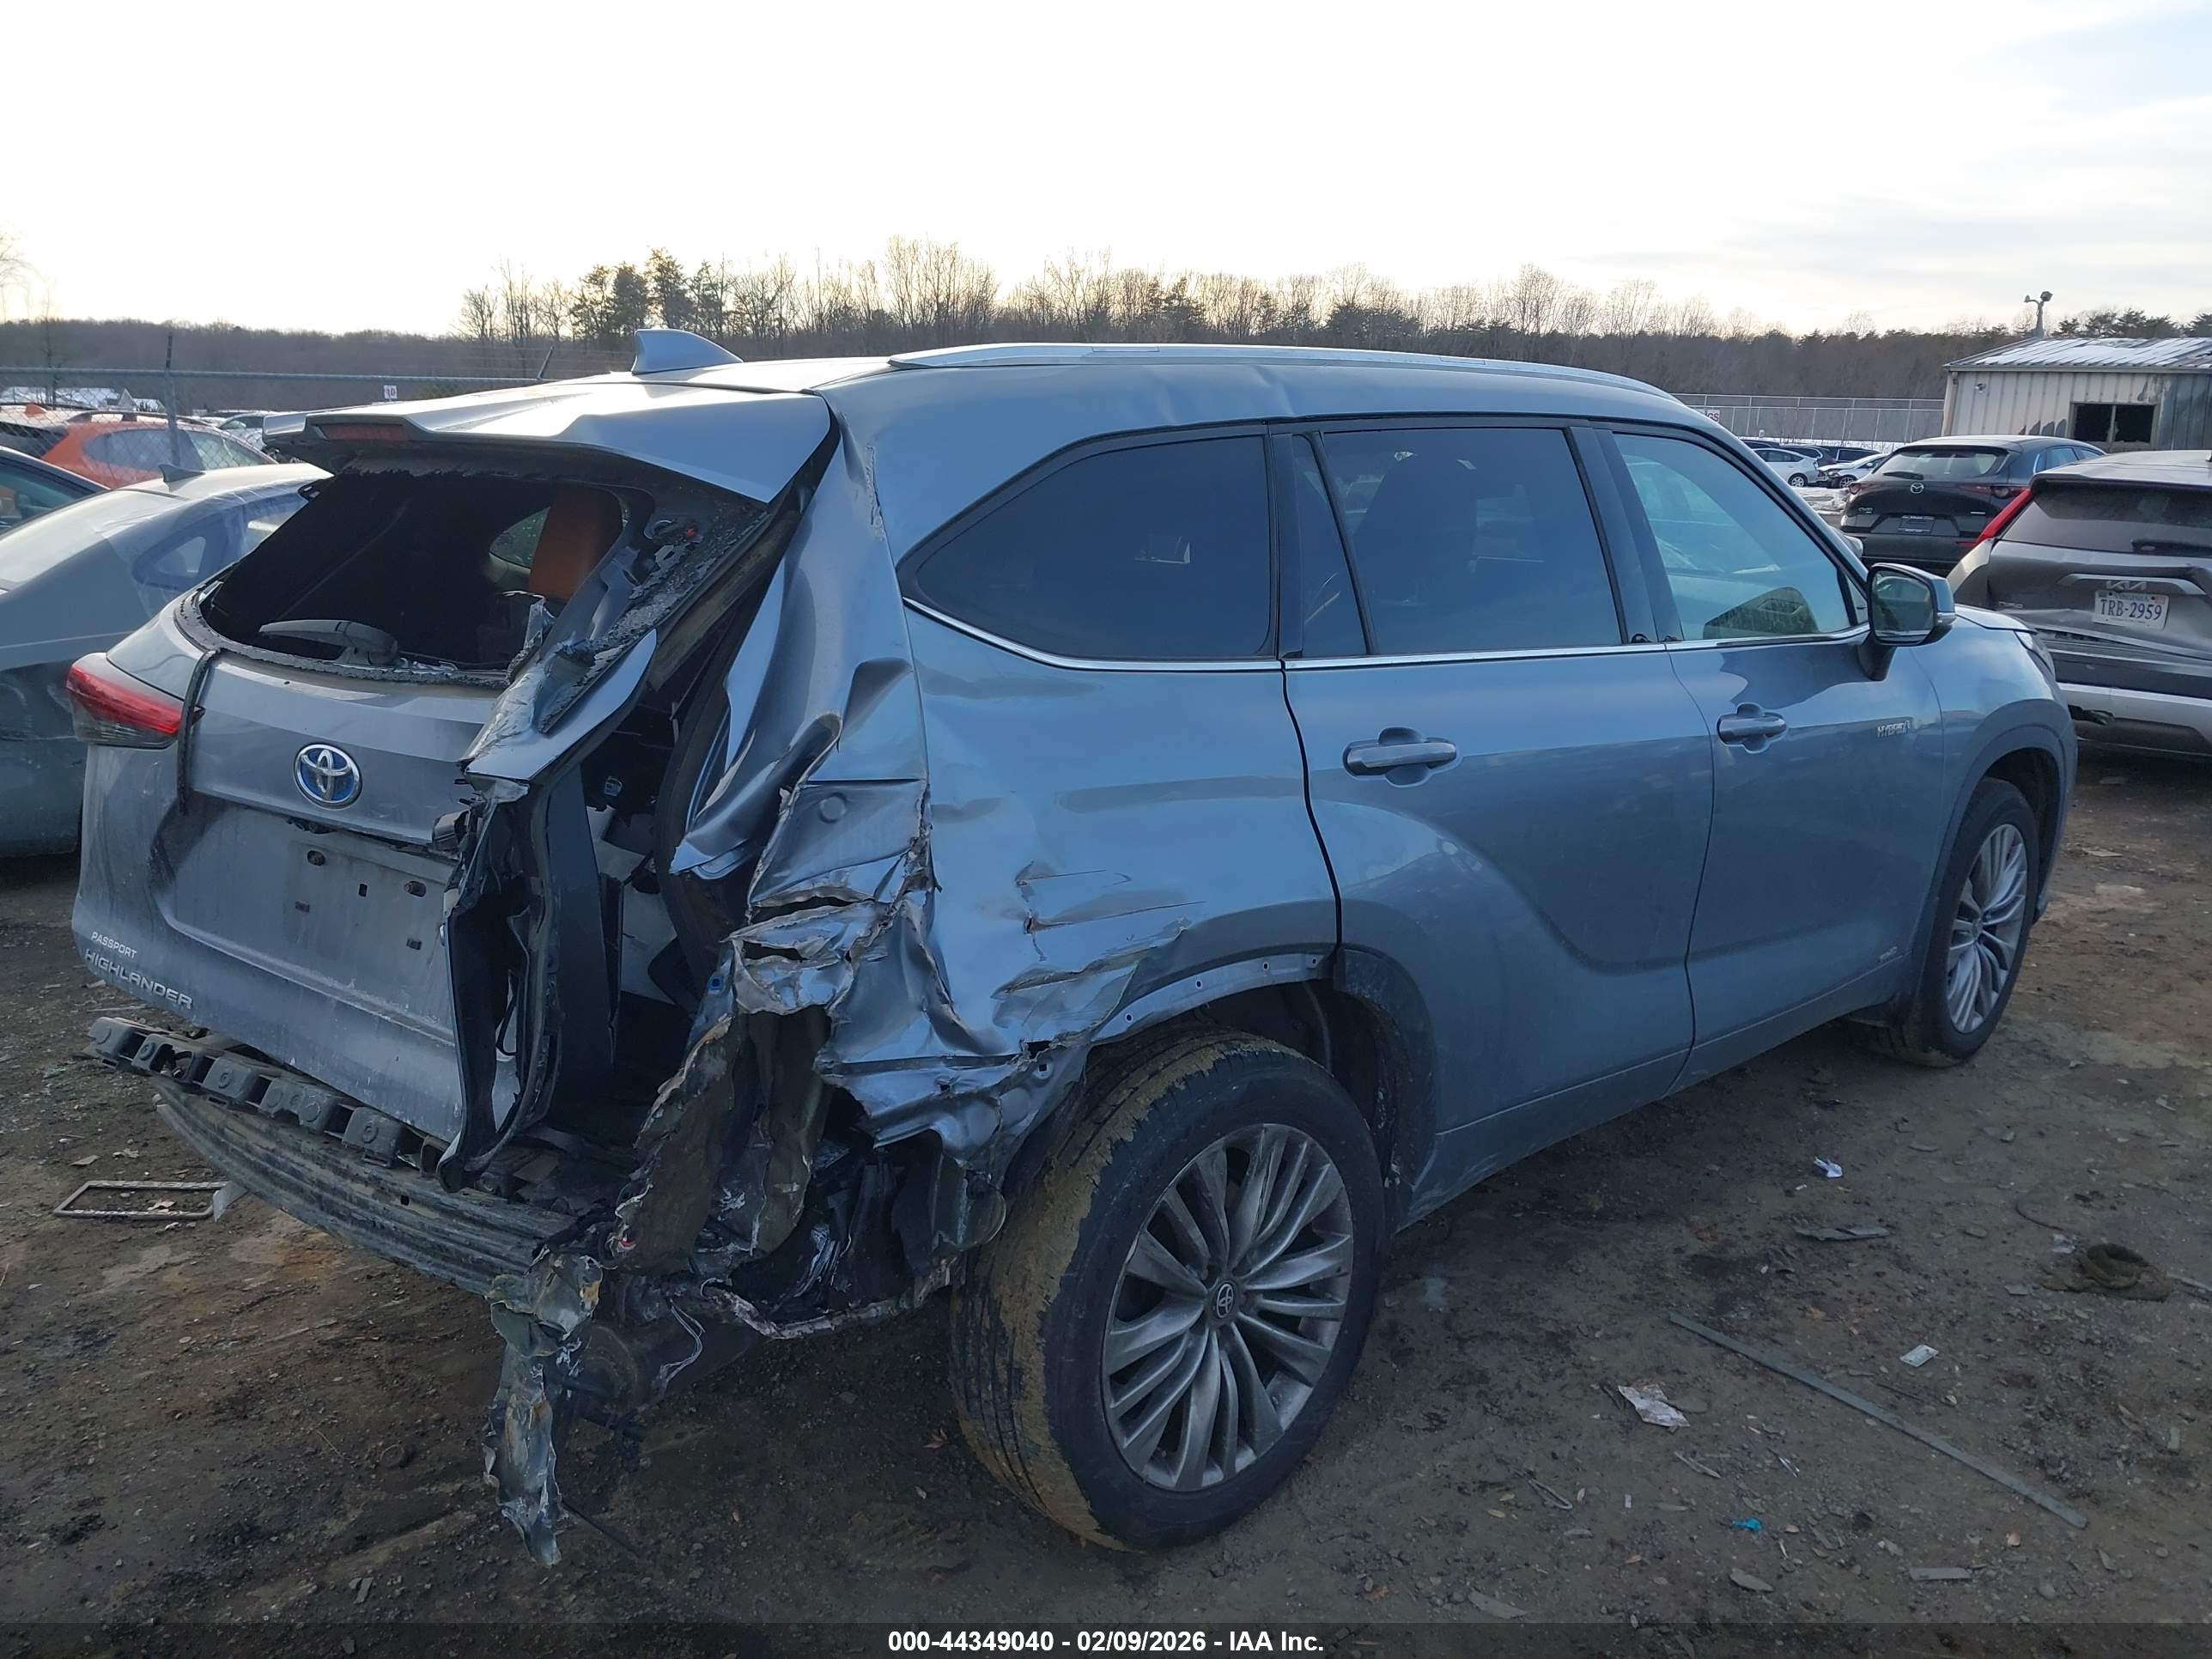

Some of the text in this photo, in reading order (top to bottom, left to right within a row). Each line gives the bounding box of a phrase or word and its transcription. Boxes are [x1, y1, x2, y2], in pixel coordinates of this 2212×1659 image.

[2100, 599, 2163, 621] TRB-2959
[91, 932, 137, 958] PASSPORT
[86, 949, 193, 1009] HIGHLANDER
